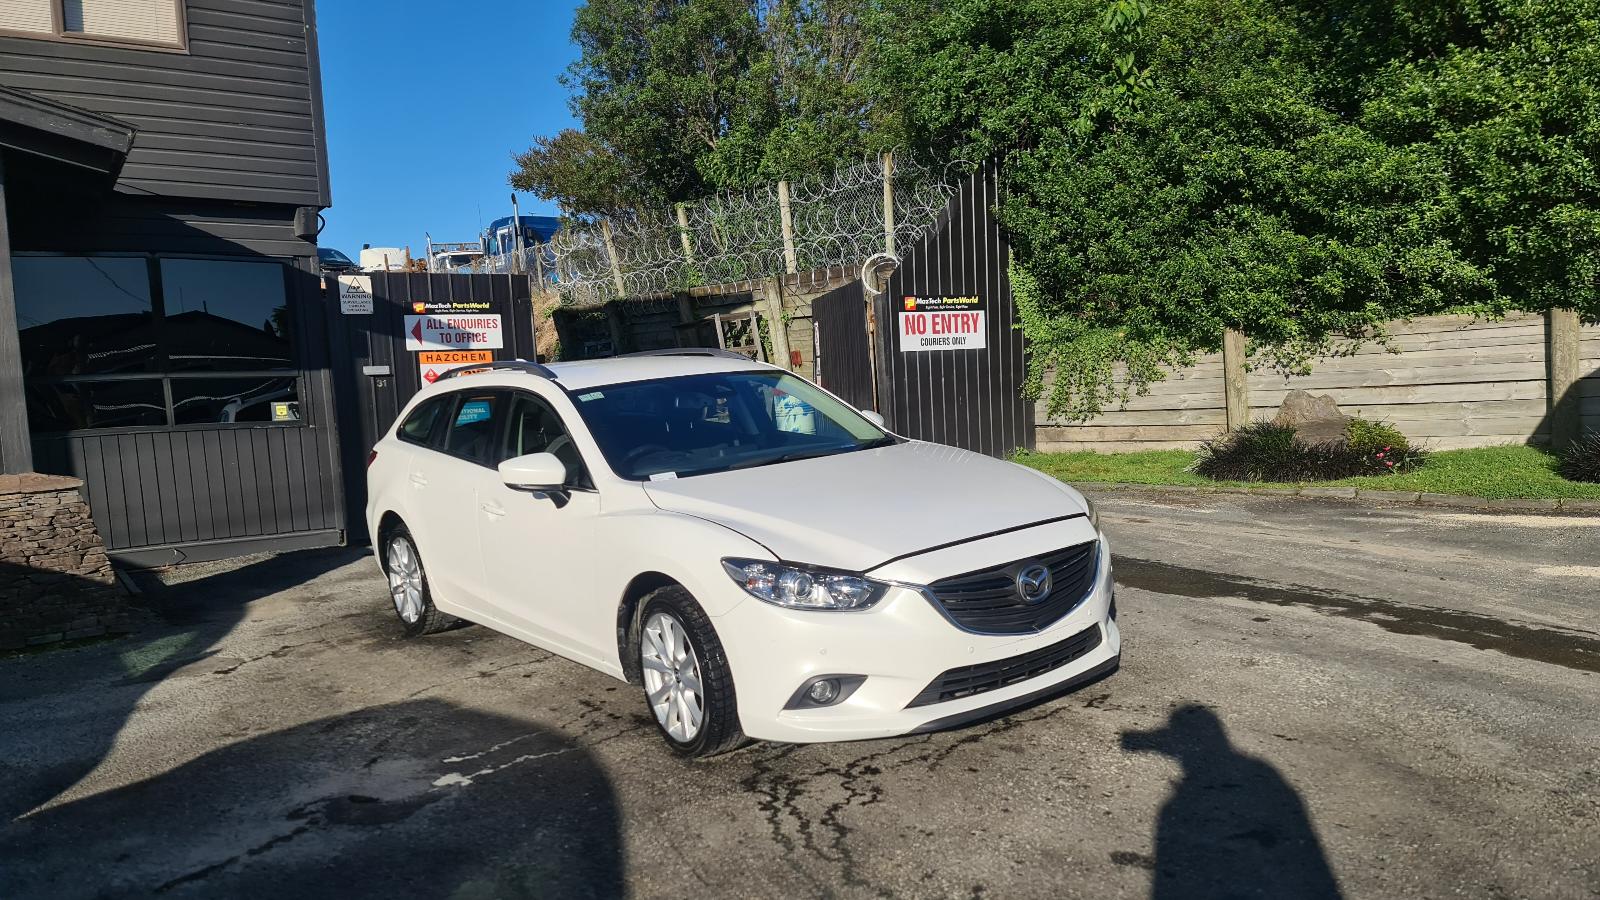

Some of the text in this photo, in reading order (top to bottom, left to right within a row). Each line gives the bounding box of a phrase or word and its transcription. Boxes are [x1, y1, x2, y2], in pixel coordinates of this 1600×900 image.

[942, 296, 979, 304] PartsWorld
[426, 318, 498, 330] ALL ENQUIRIES
[904, 313, 979, 336] NO ENTRY
[440, 332, 488, 343] TO OFFICE
[920, 337, 967, 347] COURIERS ONLY
[426, 353, 486, 362] HAZCHEM
[376, 380, 387, 388] 31
